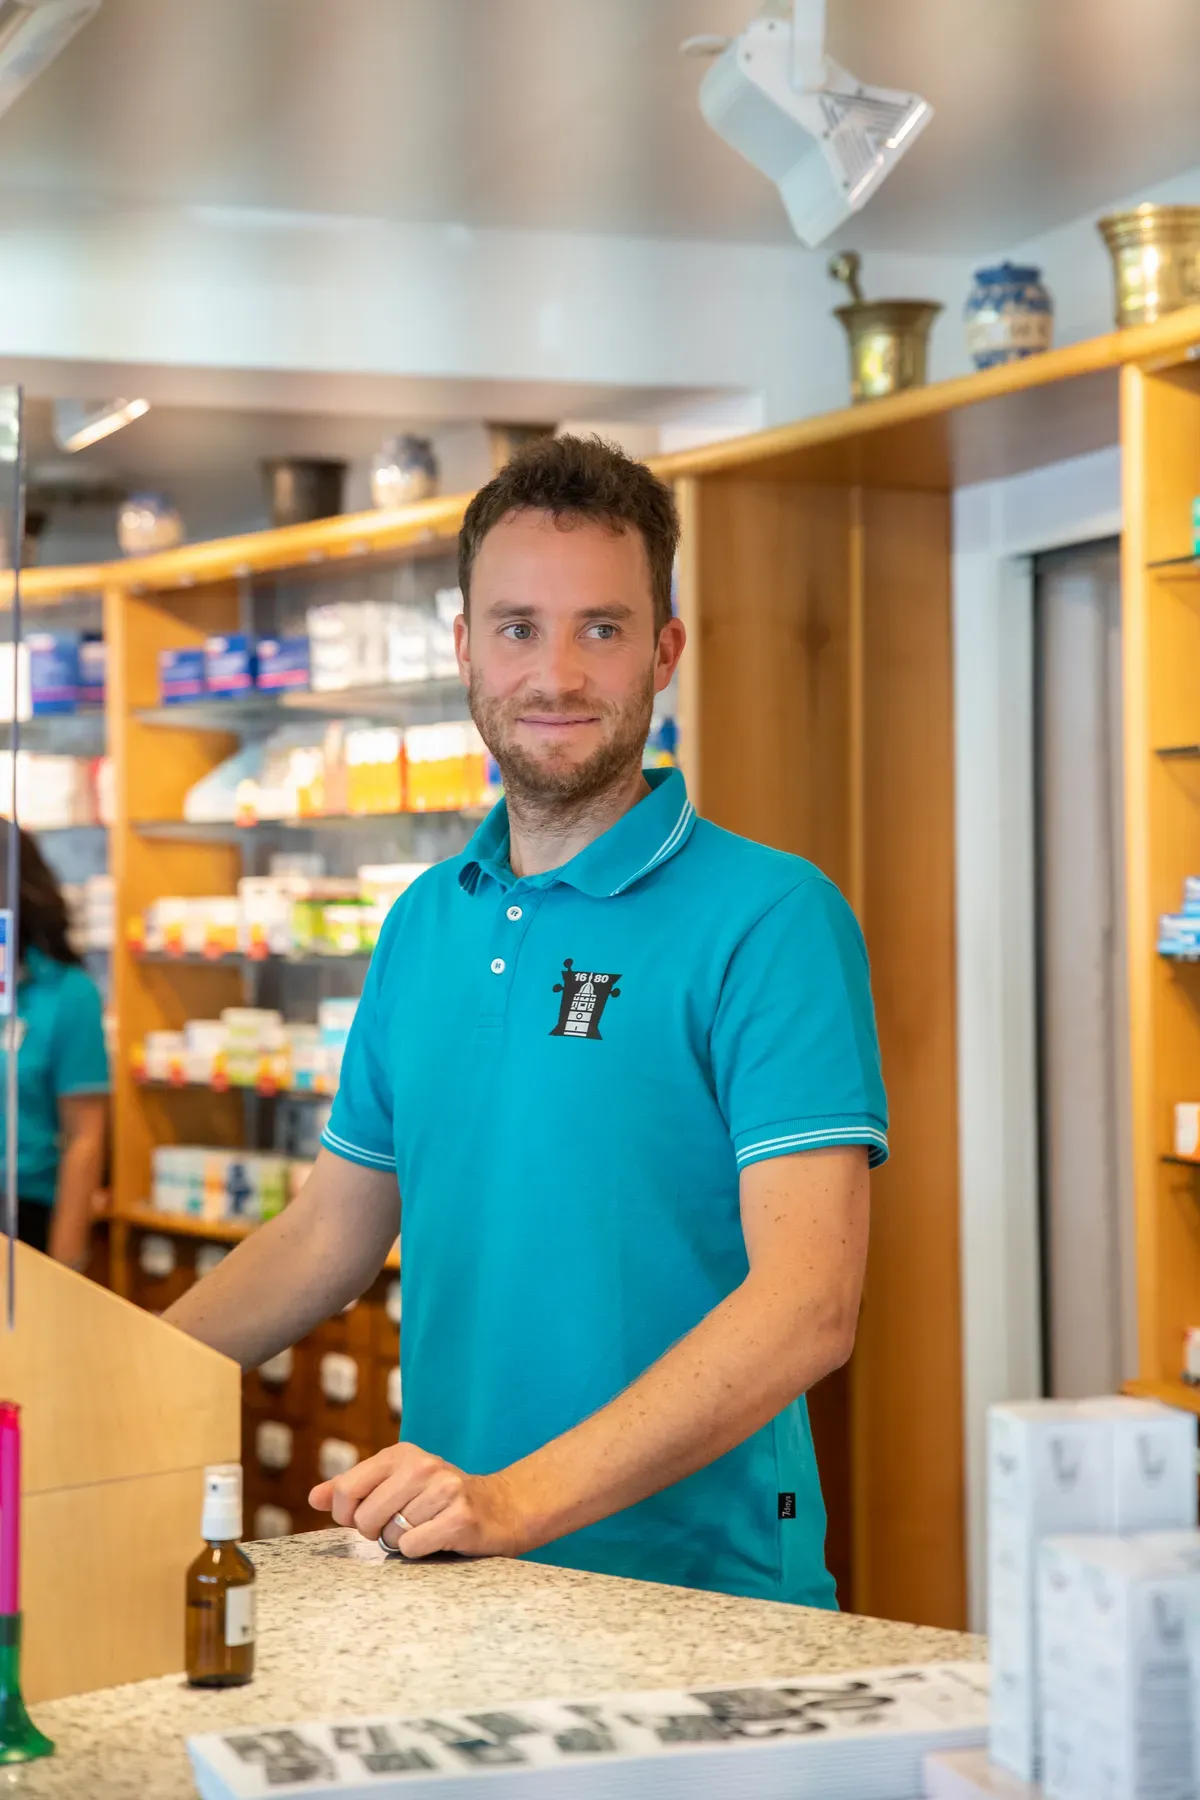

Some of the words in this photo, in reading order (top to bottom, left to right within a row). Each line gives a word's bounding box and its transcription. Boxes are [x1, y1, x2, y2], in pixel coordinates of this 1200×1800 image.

[574, 972, 587, 982] 16
[593, 974, 609, 983] 80
[782, 1495, 792, 1517] 7days
